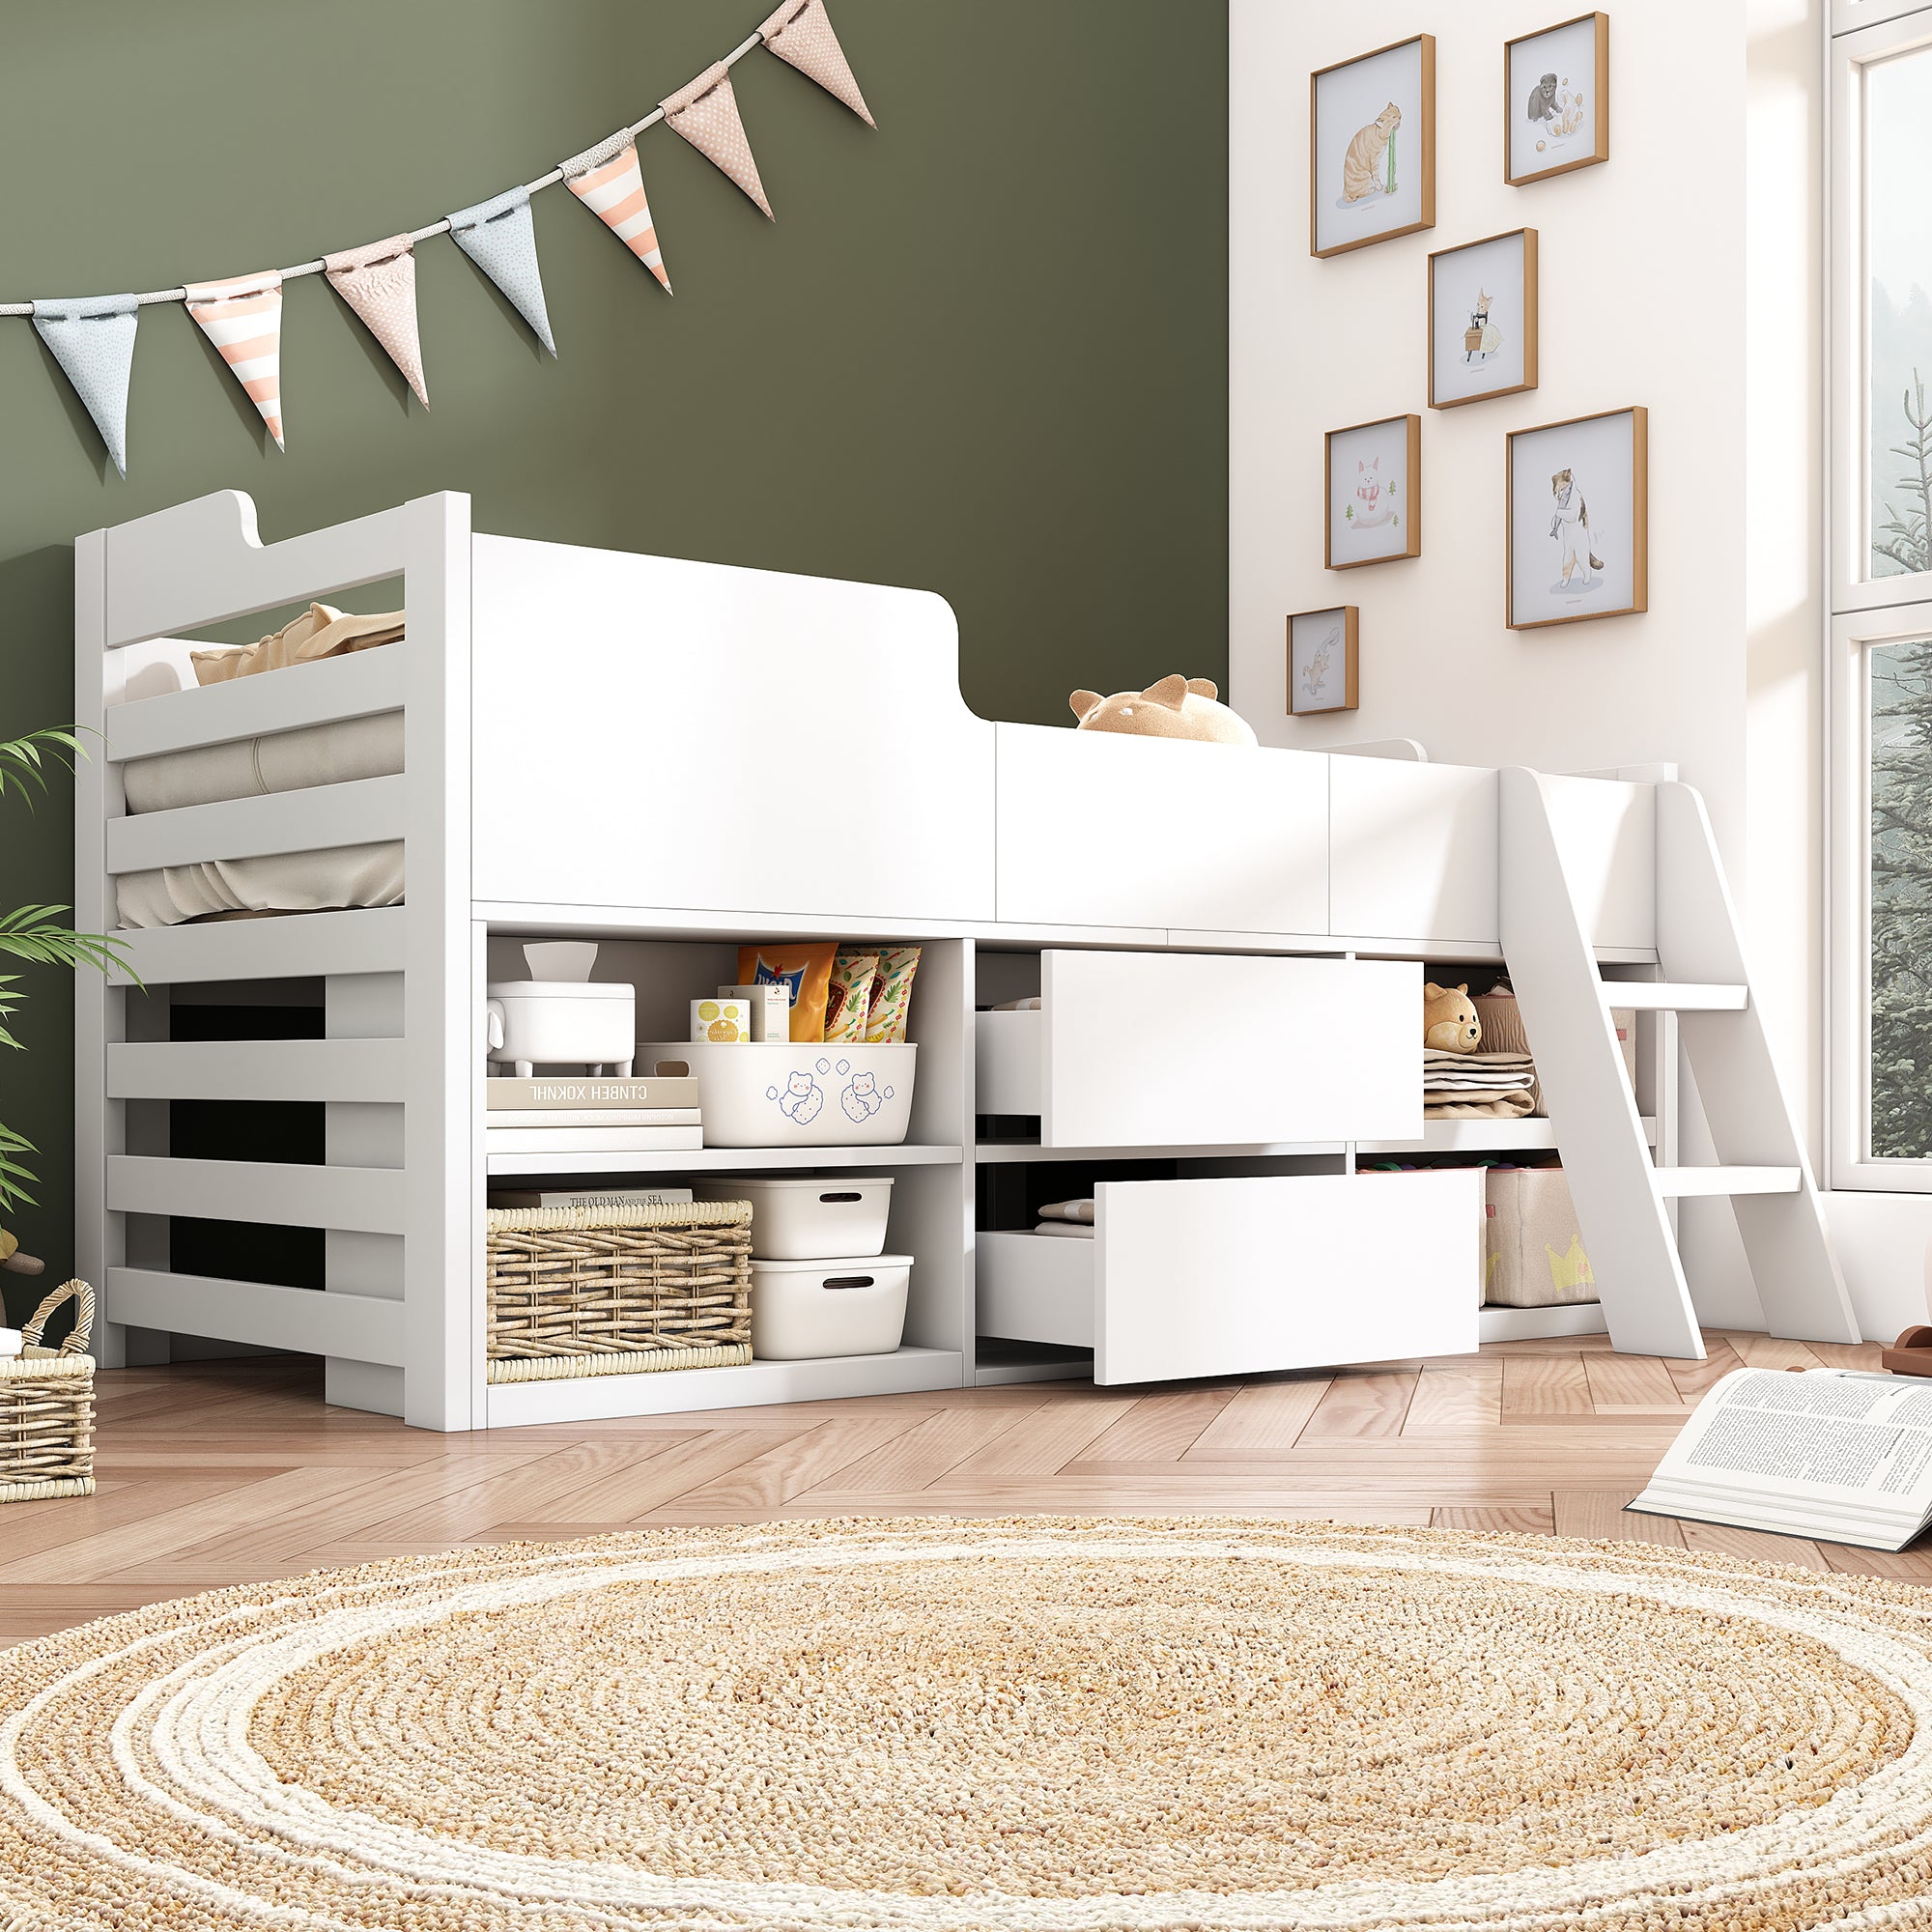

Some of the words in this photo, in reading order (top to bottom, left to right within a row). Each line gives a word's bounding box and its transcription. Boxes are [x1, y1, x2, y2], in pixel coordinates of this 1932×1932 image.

[569, 1197, 587, 1207] THE
[587, 1196, 606, 1207] OLD
[607, 1195, 625, 1206] MAN
[647, 1194, 663, 1205] SEA
